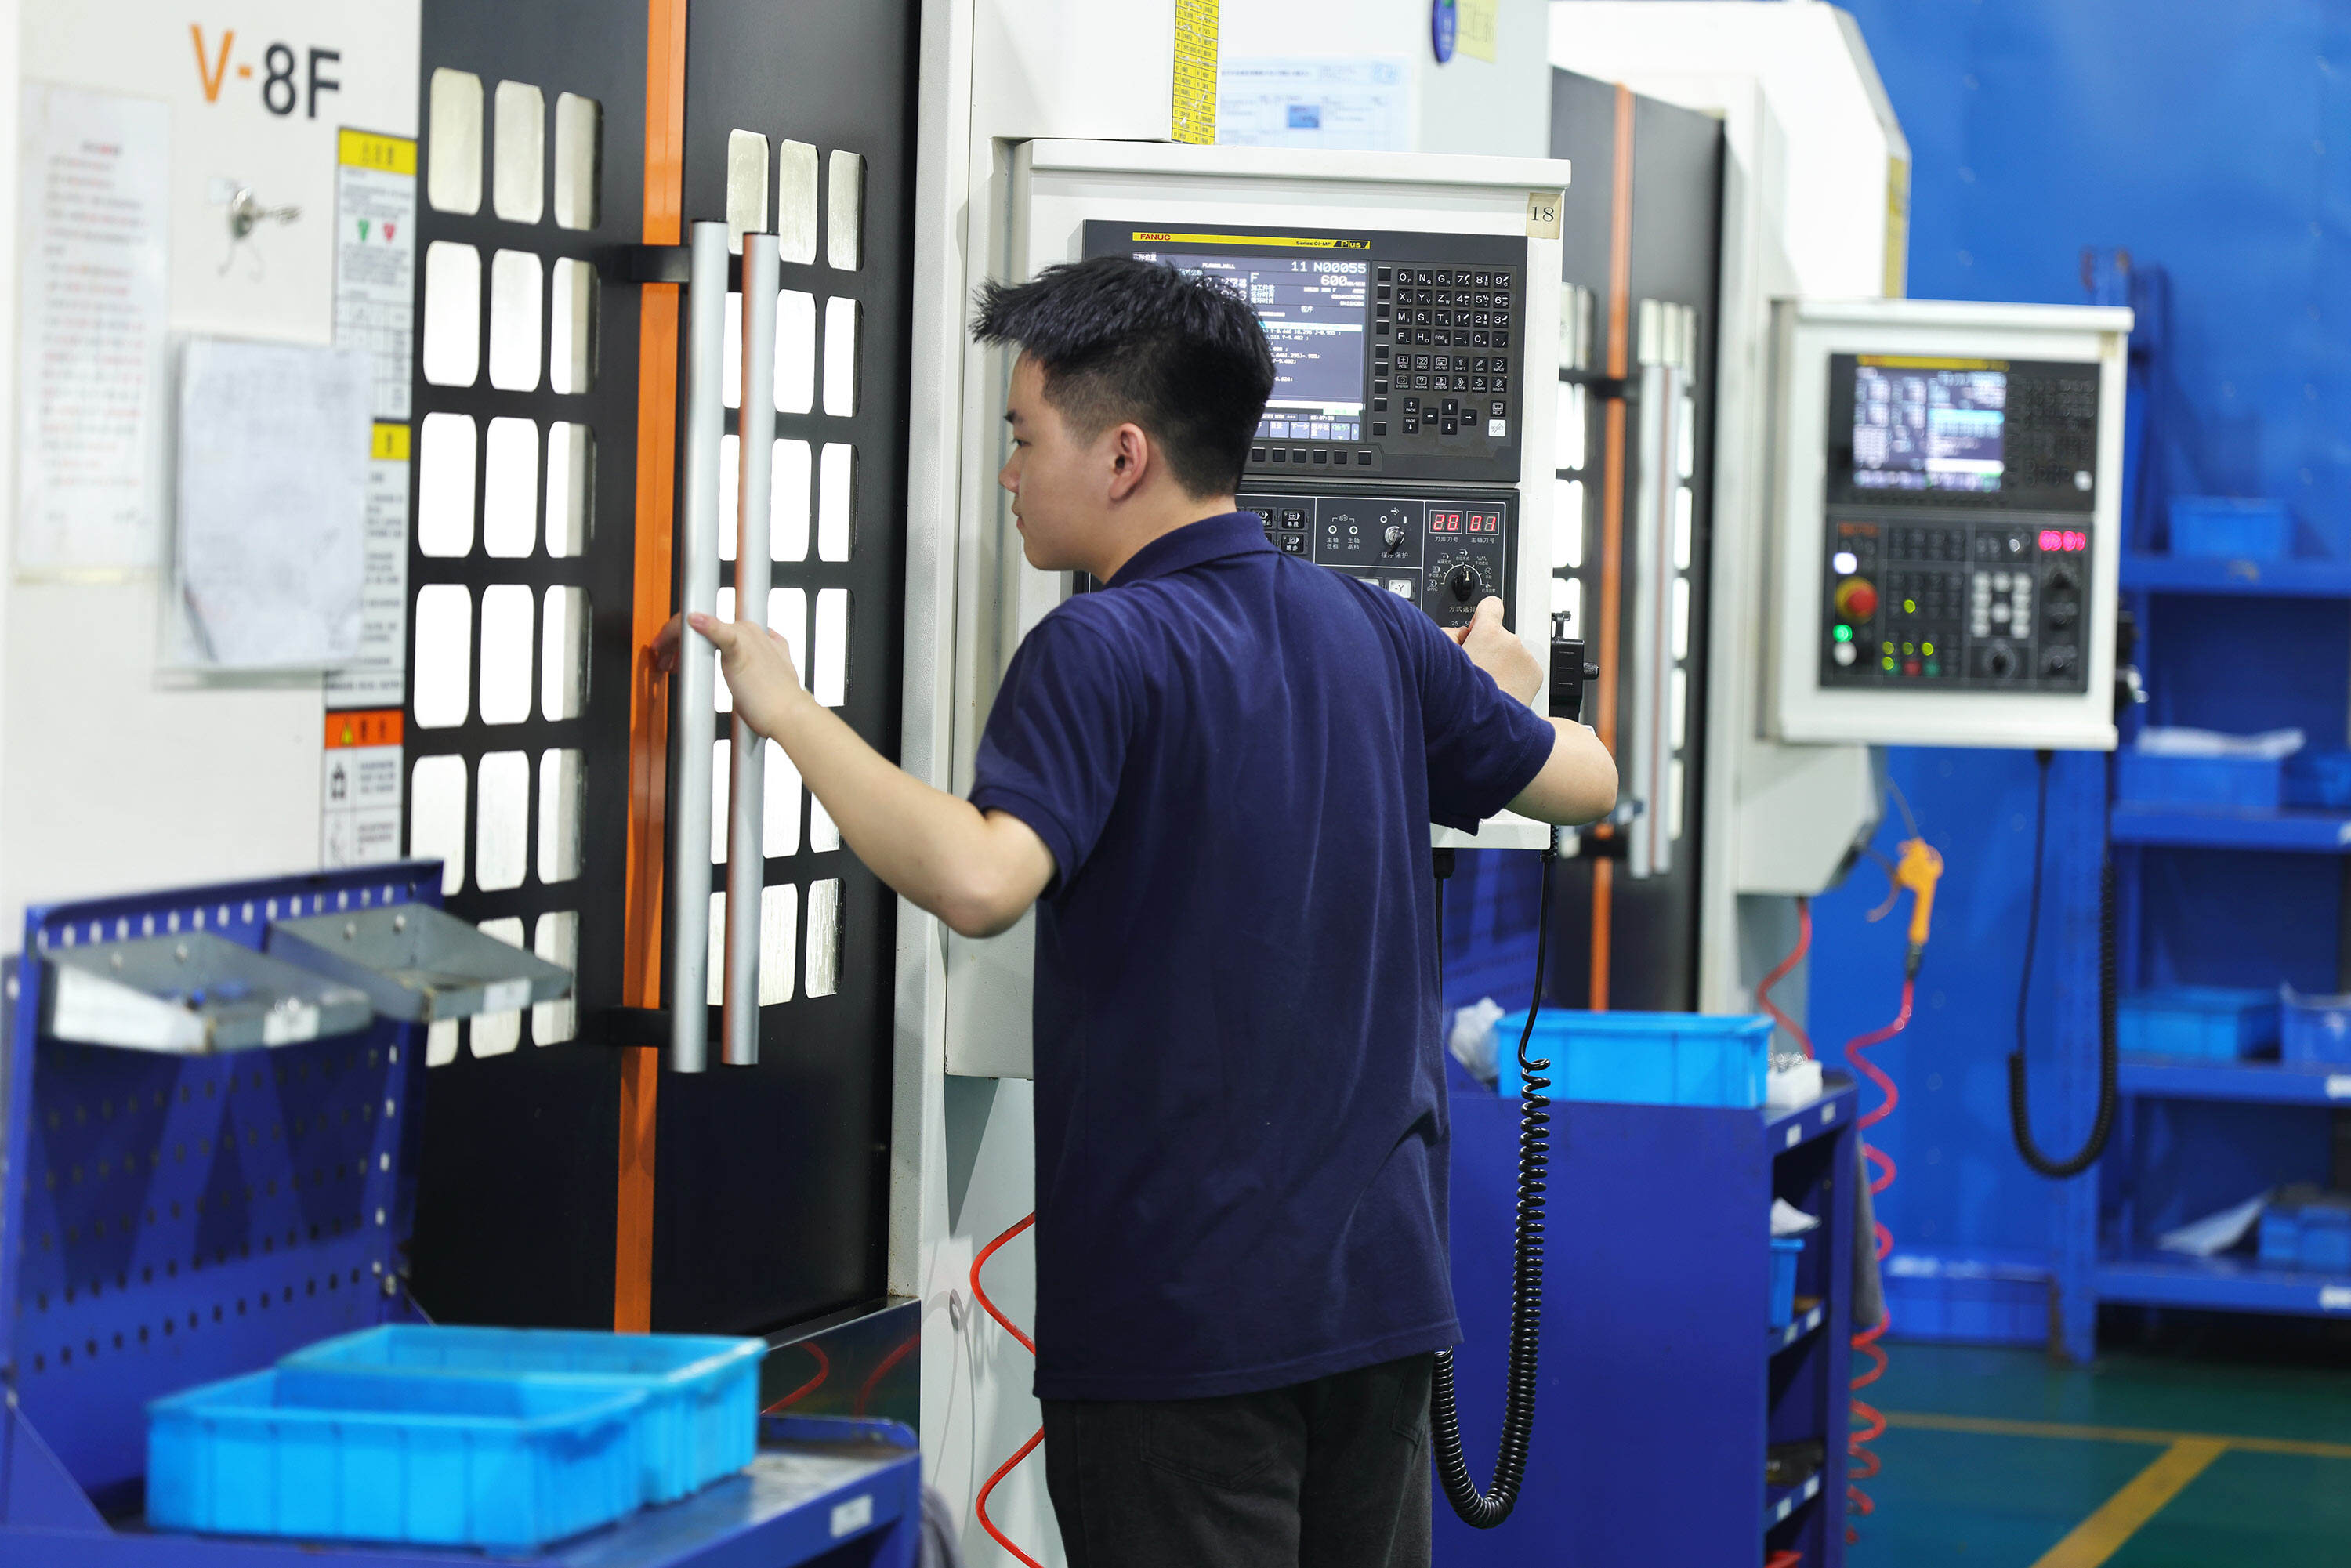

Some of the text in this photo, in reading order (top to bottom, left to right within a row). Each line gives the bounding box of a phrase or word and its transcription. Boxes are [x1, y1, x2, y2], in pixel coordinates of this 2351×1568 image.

[190, 23, 341, 119] V-8F
[1531, 206, 1554, 222] 18
[1291, 261, 1367, 273] 11 N00055
[1251, 273, 1259, 283] F
[1320, 275, 1348, 286] 600
[1399, 273, 1407, 281] O
[1437, 294, 1444, 302] Z
[1433, 514, 1459, 531] 20
[1470, 515, 1497, 532] 01
